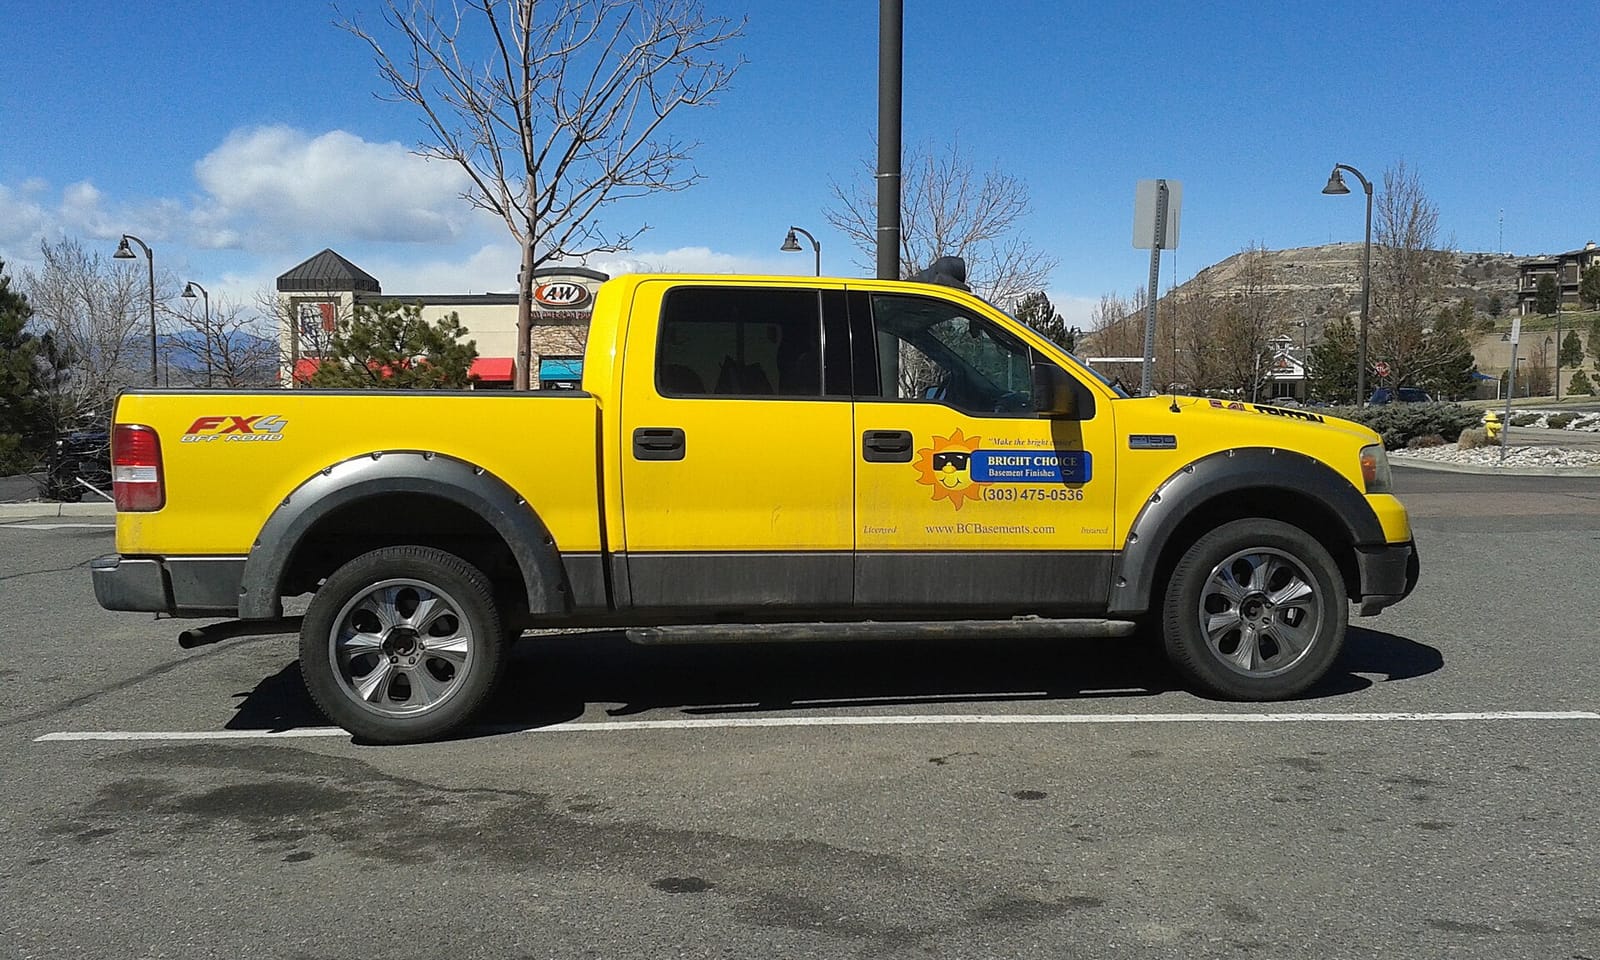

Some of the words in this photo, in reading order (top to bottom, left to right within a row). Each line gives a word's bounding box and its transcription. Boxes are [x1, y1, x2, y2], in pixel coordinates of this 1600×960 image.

[185, 415, 288, 434] FX4
[180, 434, 220, 442] OFF
[224, 434, 283, 442] ROAD
[1014, 438, 1024, 446] the
[1027, 438, 1048, 447] bright
[987, 456, 1032, 466] BRIGHT
[1033, 456, 1078, 467] CHOICE
[988, 468, 1023, 477] Basement
[1025, 468, 1055, 477] Finishes
[983, 488, 1018, 502] (303)
[1020, 488, 1083, 501] 475-0536
[863, 525, 897, 534] Licensed
[925, 523, 1055, 534] www.BCBasements.com
[1081, 526, 1108, 535] Insured
